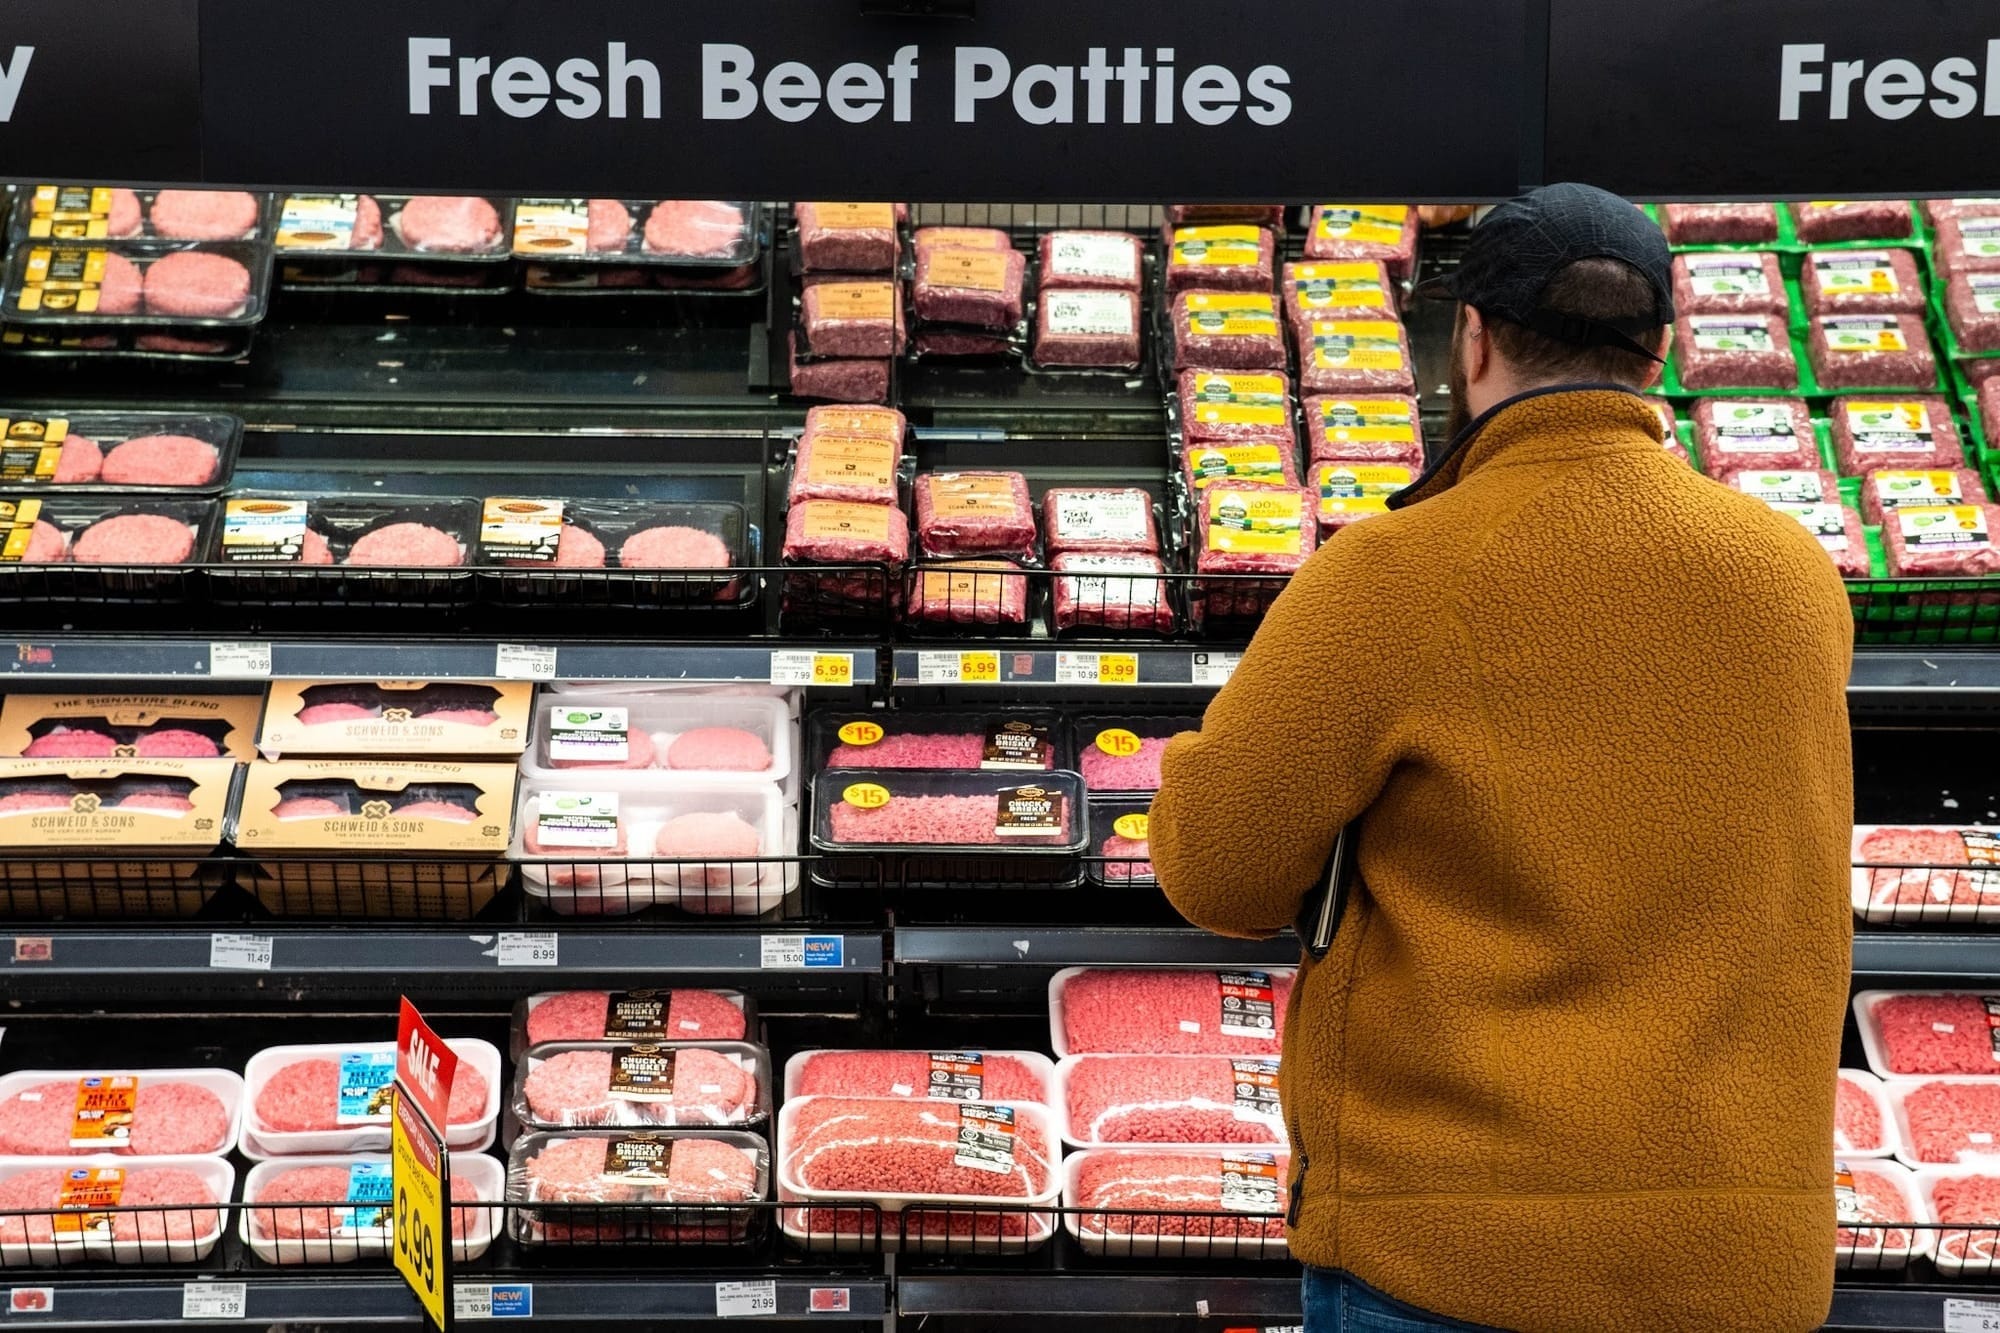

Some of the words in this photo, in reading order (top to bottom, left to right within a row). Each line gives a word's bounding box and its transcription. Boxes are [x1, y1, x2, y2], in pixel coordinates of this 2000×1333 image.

[409, 37, 661, 119] Fresh
[702, 43, 919, 123] Beef
[955, 46, 1292, 126] Patties
[248, 660, 270, 670] 10.99
[532, 663, 554, 673] 10.99
[963, 662, 996, 673] 6.99
[1101, 664, 1134, 675] 8.99
[794, 671, 810, 680] 7.99
[815, 665, 848, 676] 6.99
[942, 670, 958, 678] 7.99
[1078, 671, 1098, 679] 10.99
[53, 700, 82, 709] THE
[87, 697, 168, 705] SIGNATURE
[173, 699, 220, 710] BLEND
[845, 727, 877, 741] $15
[1102, 733, 1135, 752] $15
[850, 787, 883, 804] $15
[31, 816, 88, 828] SCHWEID
[92, 816, 99, 828] &
[102, 815, 136, 828] SONS
[323, 821, 378, 832] SCHWEID
[382, 821, 389, 832] &
[393, 821, 424, 833] SONS
[805, 942, 834, 951] NEW!
[248, 953, 270, 963] 11.49
[533, 949, 555, 959] 8.99
[783, 954, 803, 962] 15.00
[408, 1028, 440, 1102] SALE
[620, 1056, 657, 1064] CHUCK
[621, 1062, 667, 1071] BRISKET
[616, 1149, 663, 1157] BRISKET
[400, 1186, 434, 1293] 8.99
[493, 1291, 522, 1301] NEW!
[221, 1303, 239, 1312] 9.99
[470, 1303, 491, 1312] 10.99
[752, 1298, 774, 1309] 21.99
